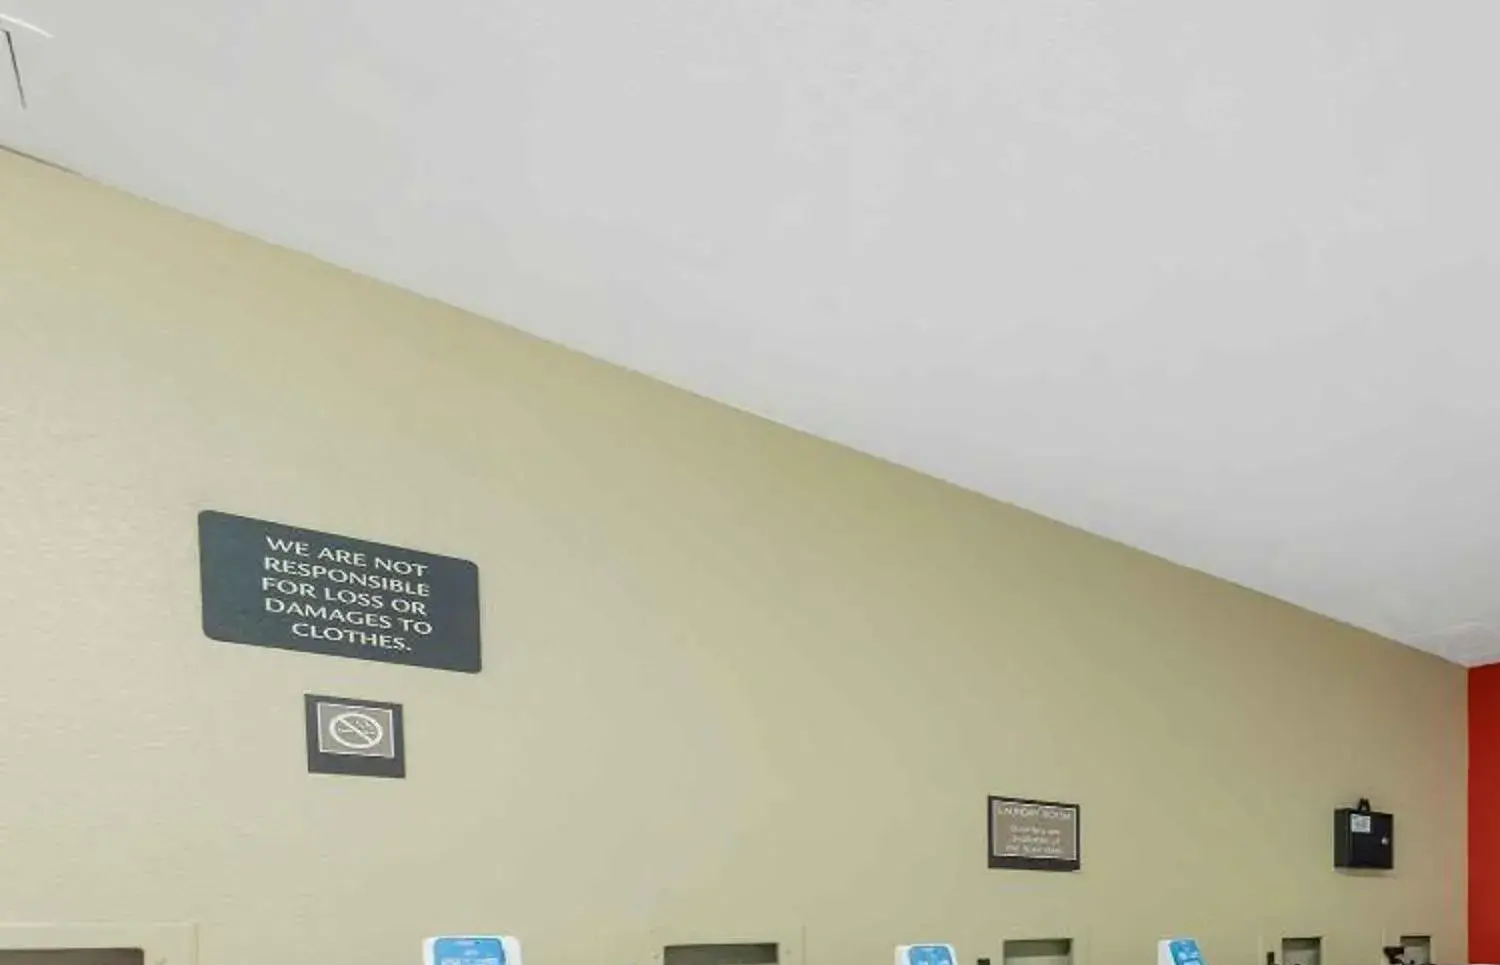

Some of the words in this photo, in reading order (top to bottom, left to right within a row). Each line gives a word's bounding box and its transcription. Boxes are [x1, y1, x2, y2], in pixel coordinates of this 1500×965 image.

[265, 535, 310, 556] WE
[317, 546, 367, 567] ARE
[374, 556, 429, 577] NOT
[261, 577, 317, 599] FOR
[324, 587, 384, 609] LOSS
[391, 599, 428, 616] OR
[263, 557, 431, 597] RESPONSIBLE
[264, 597, 393, 629] DAMAGES
[400, 618, 433, 635] TO
[291, 622, 413, 651] CLOTHES.
